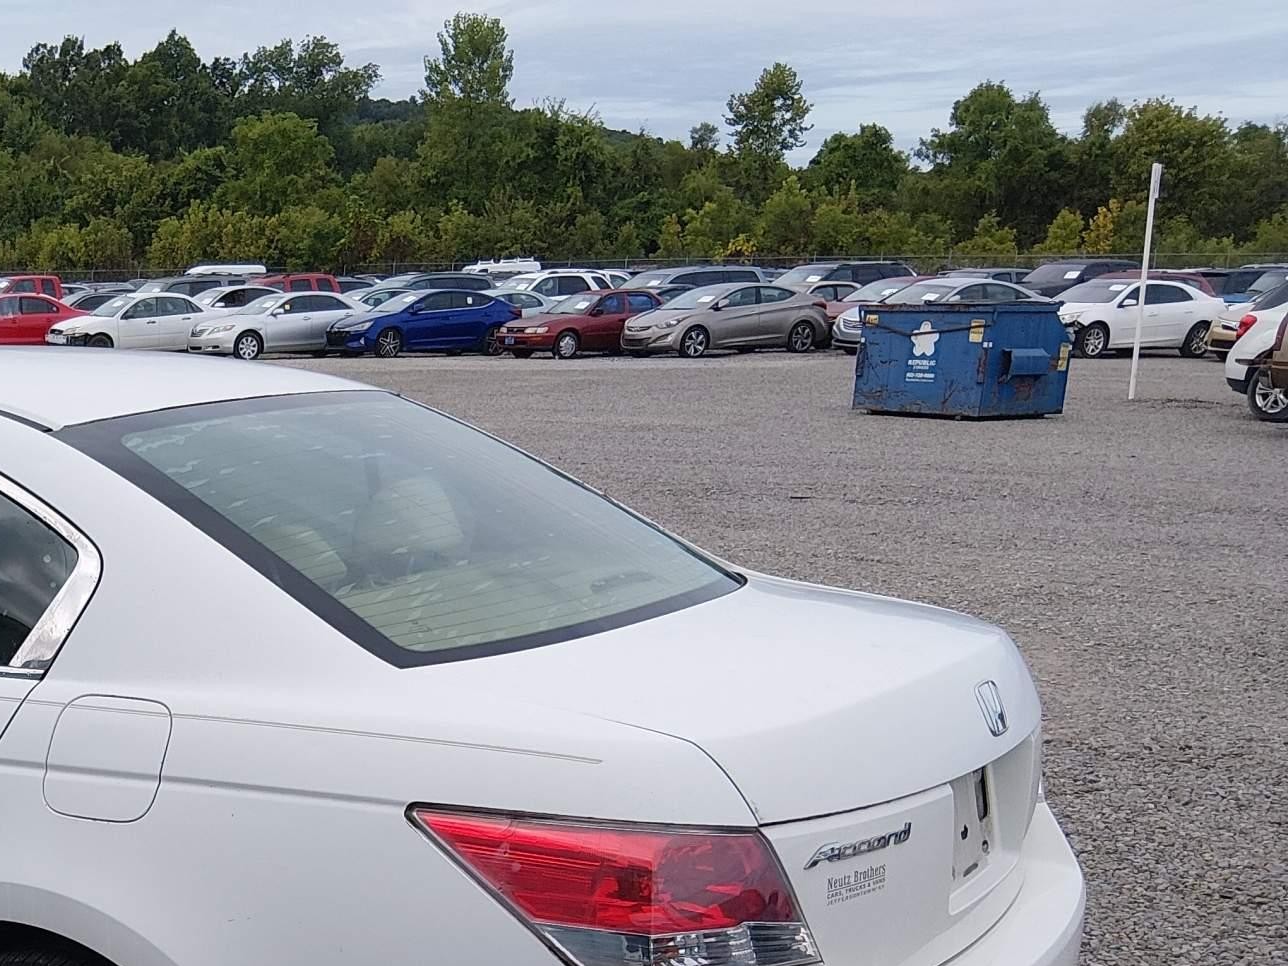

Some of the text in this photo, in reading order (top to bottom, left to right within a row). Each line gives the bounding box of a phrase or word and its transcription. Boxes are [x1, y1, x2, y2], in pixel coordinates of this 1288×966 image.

[803, 822, 912, 870] Accord
[827, 863, 886, 891] Neutz Brothers
